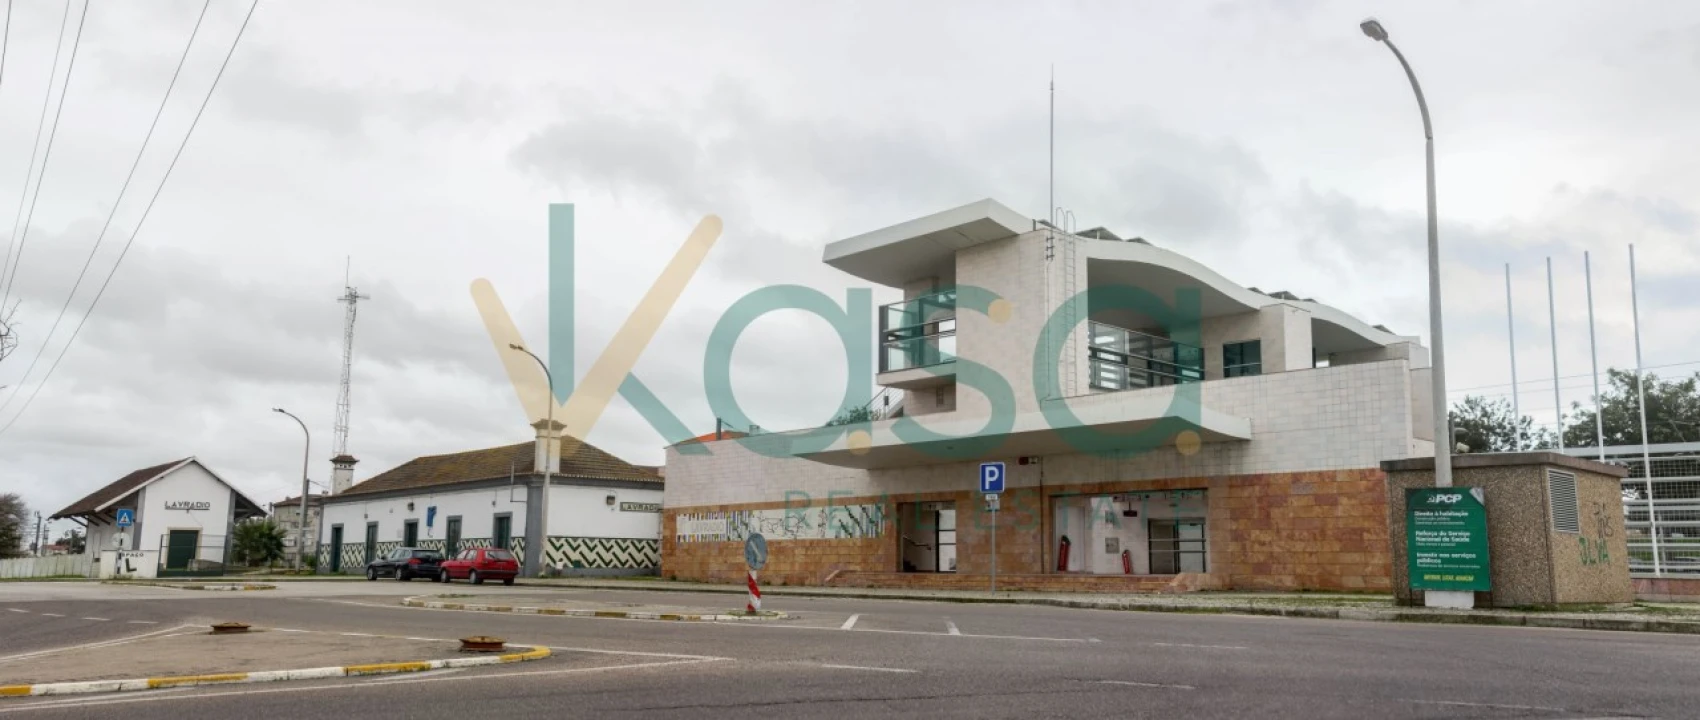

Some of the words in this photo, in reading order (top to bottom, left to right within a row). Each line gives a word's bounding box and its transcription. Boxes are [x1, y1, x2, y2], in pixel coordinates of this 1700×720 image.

[985, 466, 999, 490] P
[1436, 493, 1462, 503] PCP
[164, 501, 211, 510] LAVRADIO
